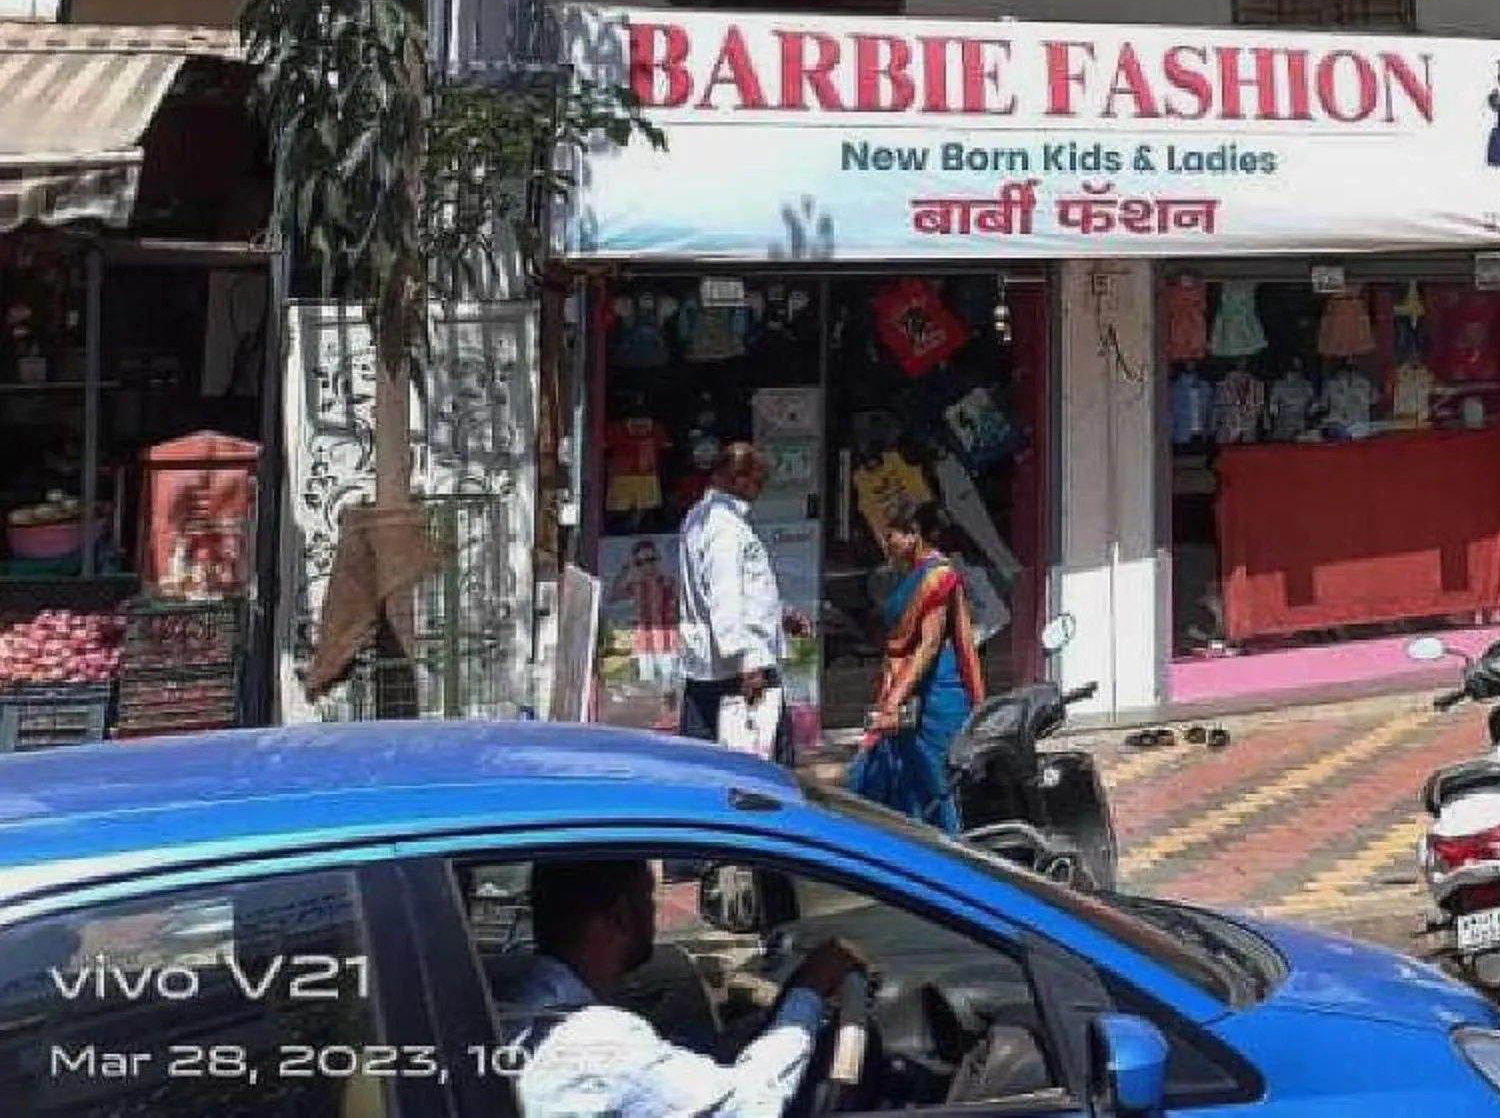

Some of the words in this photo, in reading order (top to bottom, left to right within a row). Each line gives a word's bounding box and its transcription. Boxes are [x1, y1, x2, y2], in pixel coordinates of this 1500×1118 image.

[625, 21, 1018, 116] BARBIE
[1040, 39, 1437, 125] FASHION
[840, 140, 930, 172] New
[940, 141, 1030, 172] Born
[1042, 140, 1123, 173] Kids
[1132, 144, 1156, 174] &
[1166, 142, 1280, 175] Ladies
[910, 177, 1042, 236] बार्बी
[1054, 180, 1222, 236] फॅशन
